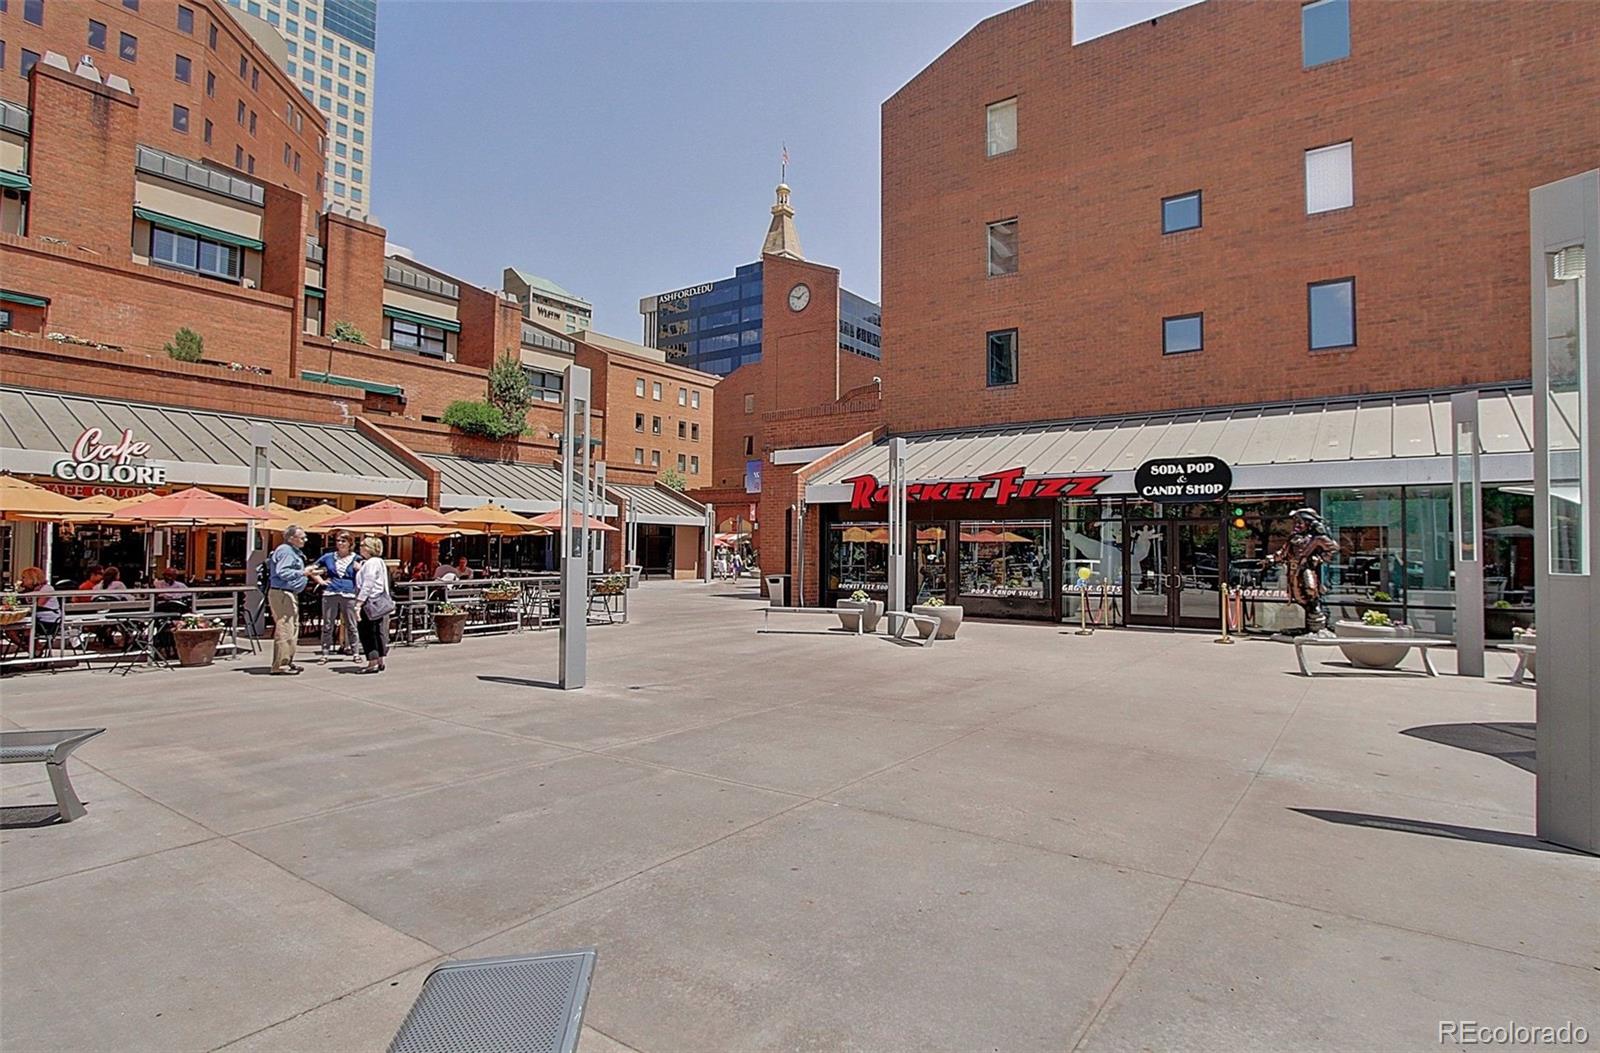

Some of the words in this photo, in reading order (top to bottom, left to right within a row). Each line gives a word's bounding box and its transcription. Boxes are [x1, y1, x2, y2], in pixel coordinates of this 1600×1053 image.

[659, 283, 714, 304] ASHFORD.EDU
[72, 427, 151, 464] Cafe
[54, 461, 166, 485] COLORE
[1150, 464, 1185, 475] SODA
[1186, 462, 1215, 474] POP
[978, 467, 1112, 505] FIZZ
[1142, 485, 1184, 496] CANDY
[1185, 484, 1224, 495] SHOP
[1176, 475, 1188, 484] &
